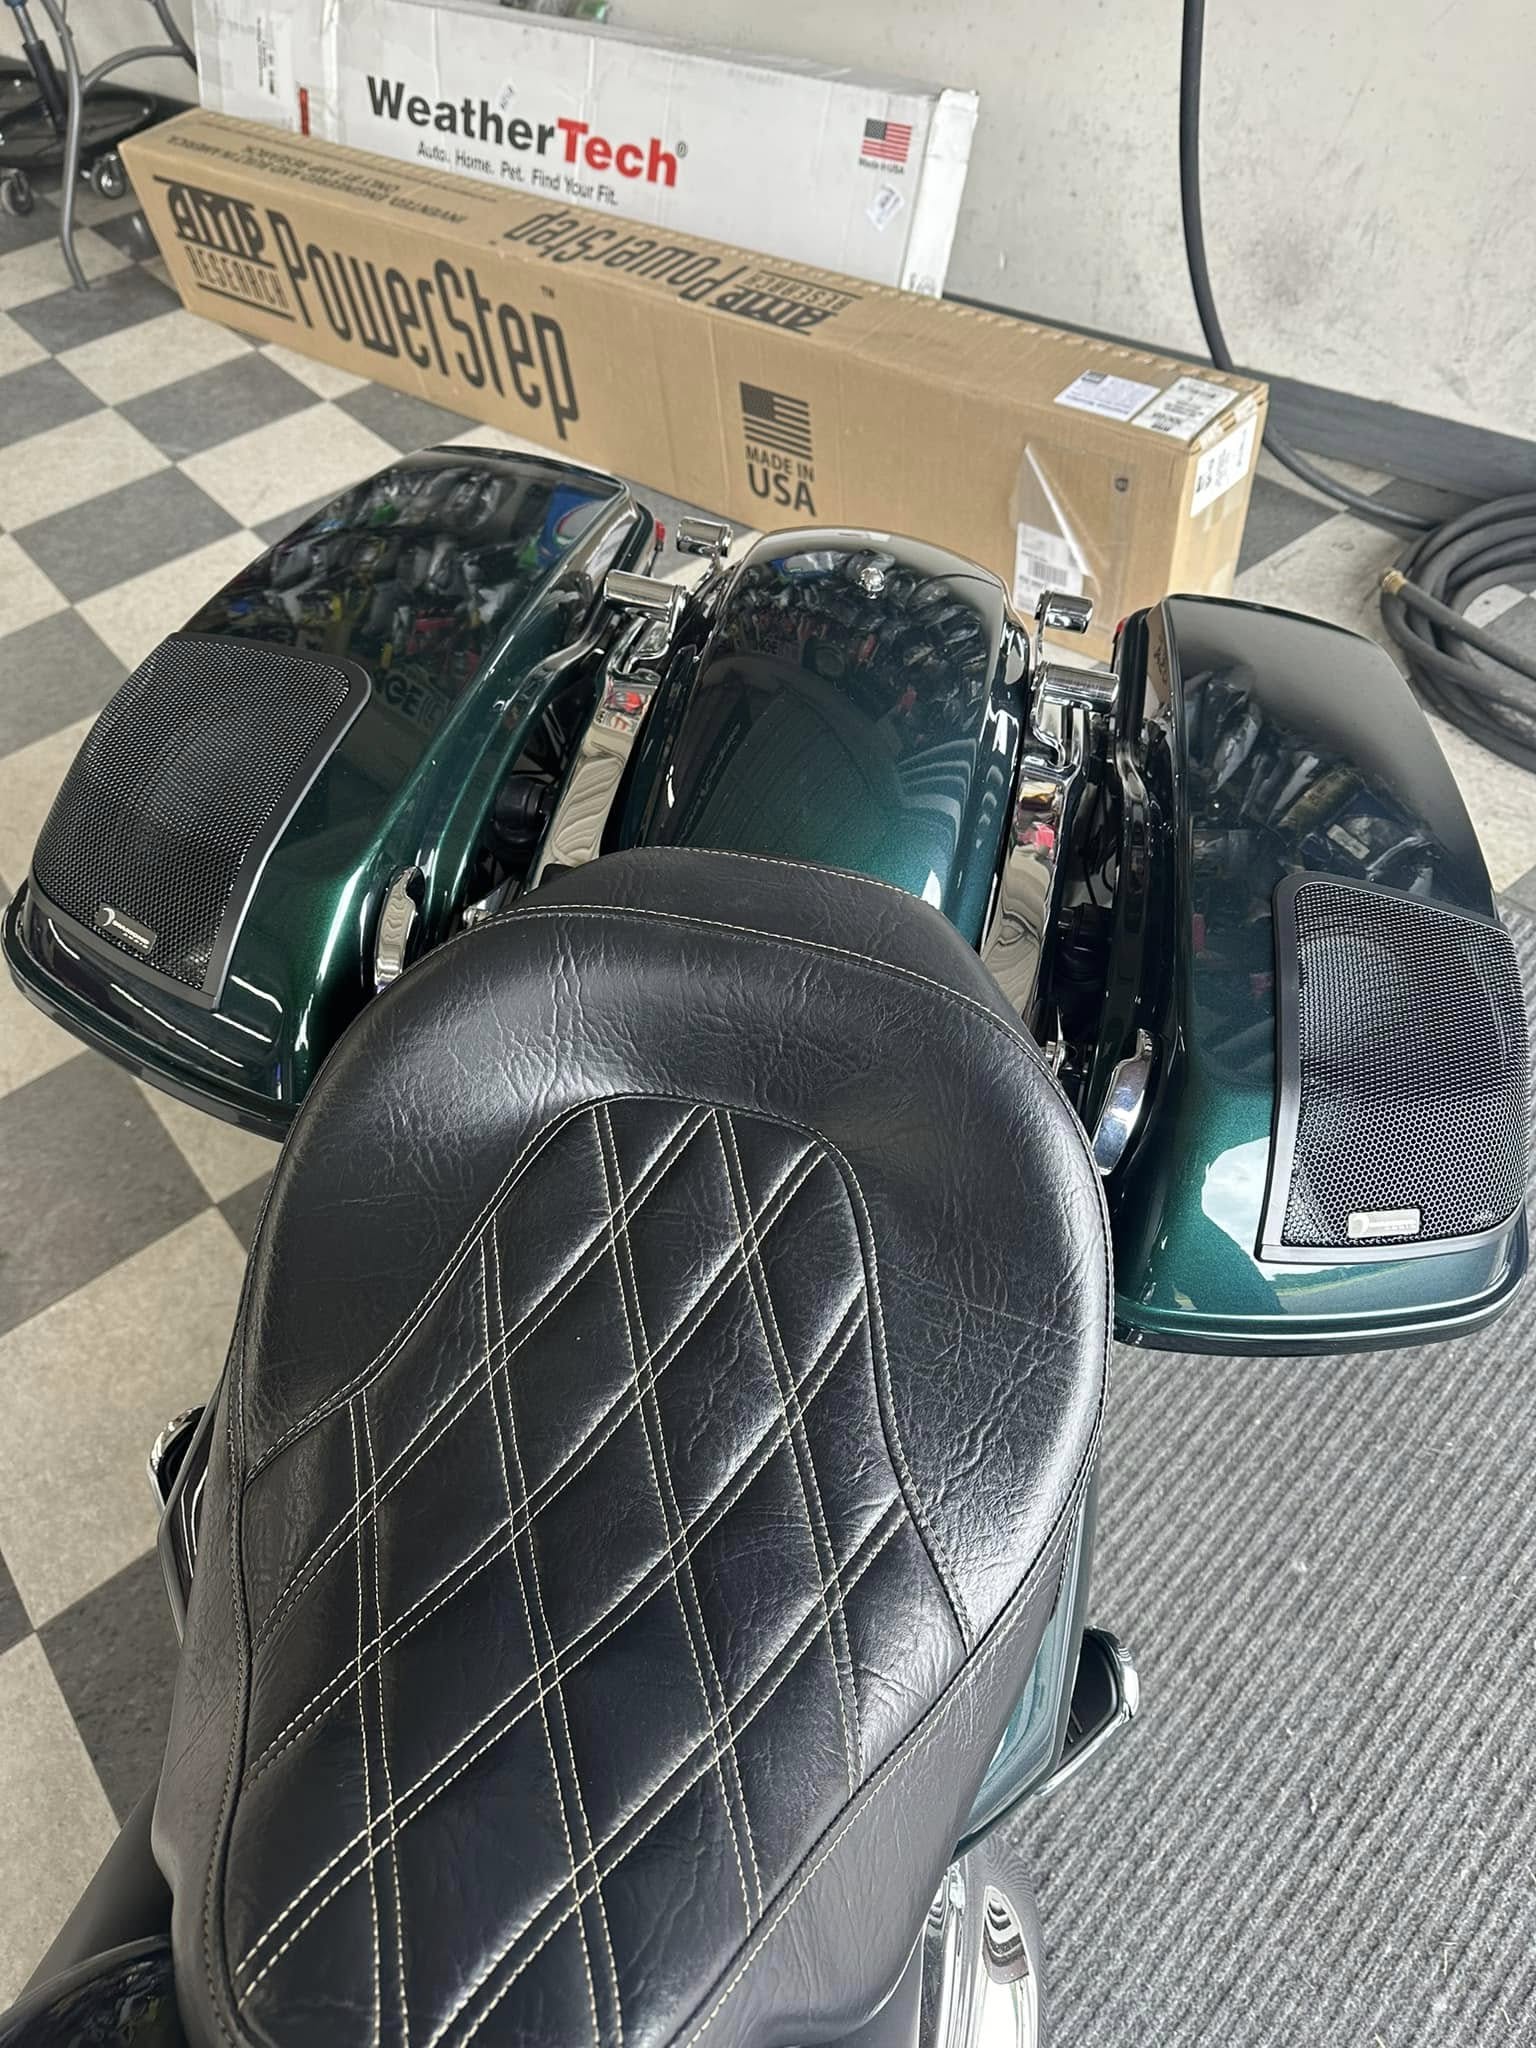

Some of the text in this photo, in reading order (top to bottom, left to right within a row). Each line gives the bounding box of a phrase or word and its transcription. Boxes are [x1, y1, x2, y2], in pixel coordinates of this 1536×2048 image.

[455, 149, 495, 176] Home.
[531, 168, 561, 192] Find
[564, 176, 594, 199] Your
[184, 245, 290, 310] RESEARCH
[742, 269, 853, 311] RESEARCH
[745, 445, 816, 483] MADE IN
[747, 463, 817, 518] USA
